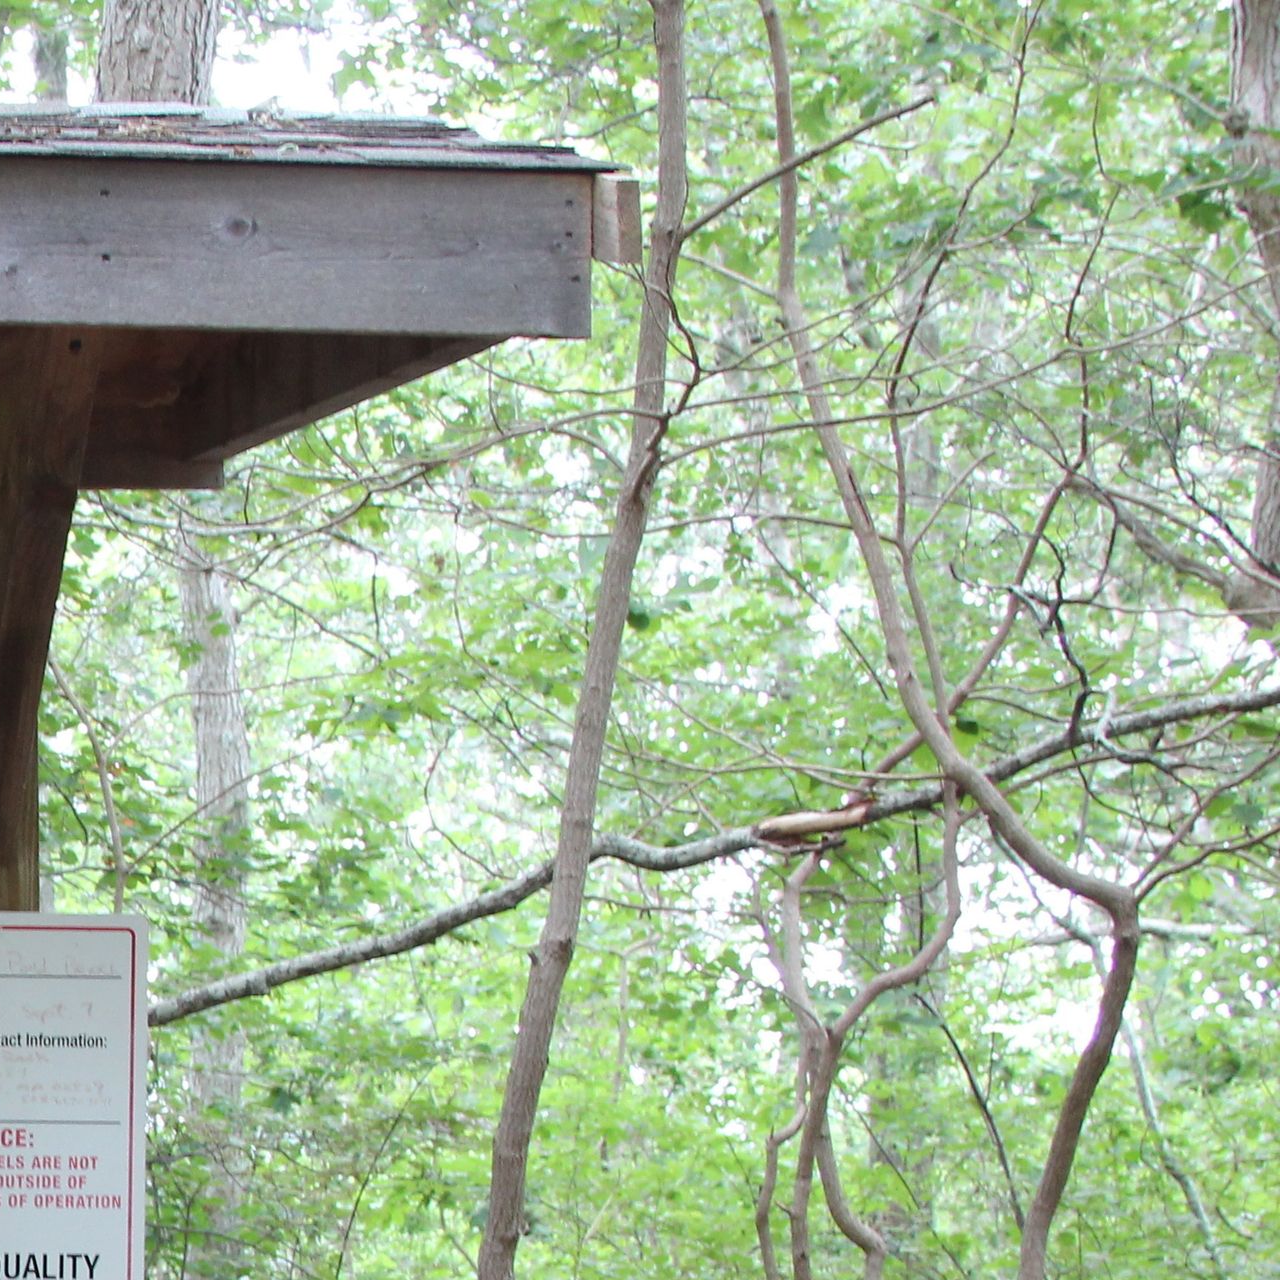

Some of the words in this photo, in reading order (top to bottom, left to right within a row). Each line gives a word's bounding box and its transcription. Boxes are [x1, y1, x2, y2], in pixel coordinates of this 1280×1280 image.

[26, 1033, 106, 1048] Information:
[32, 1156, 61, 1169] ARE
[69, 1156, 97, 1170] NOT
[68, 1175, 86, 1189] OF
[8, 1194, 27, 1208] OF
[34, 1194, 121, 1208] OPERATION
